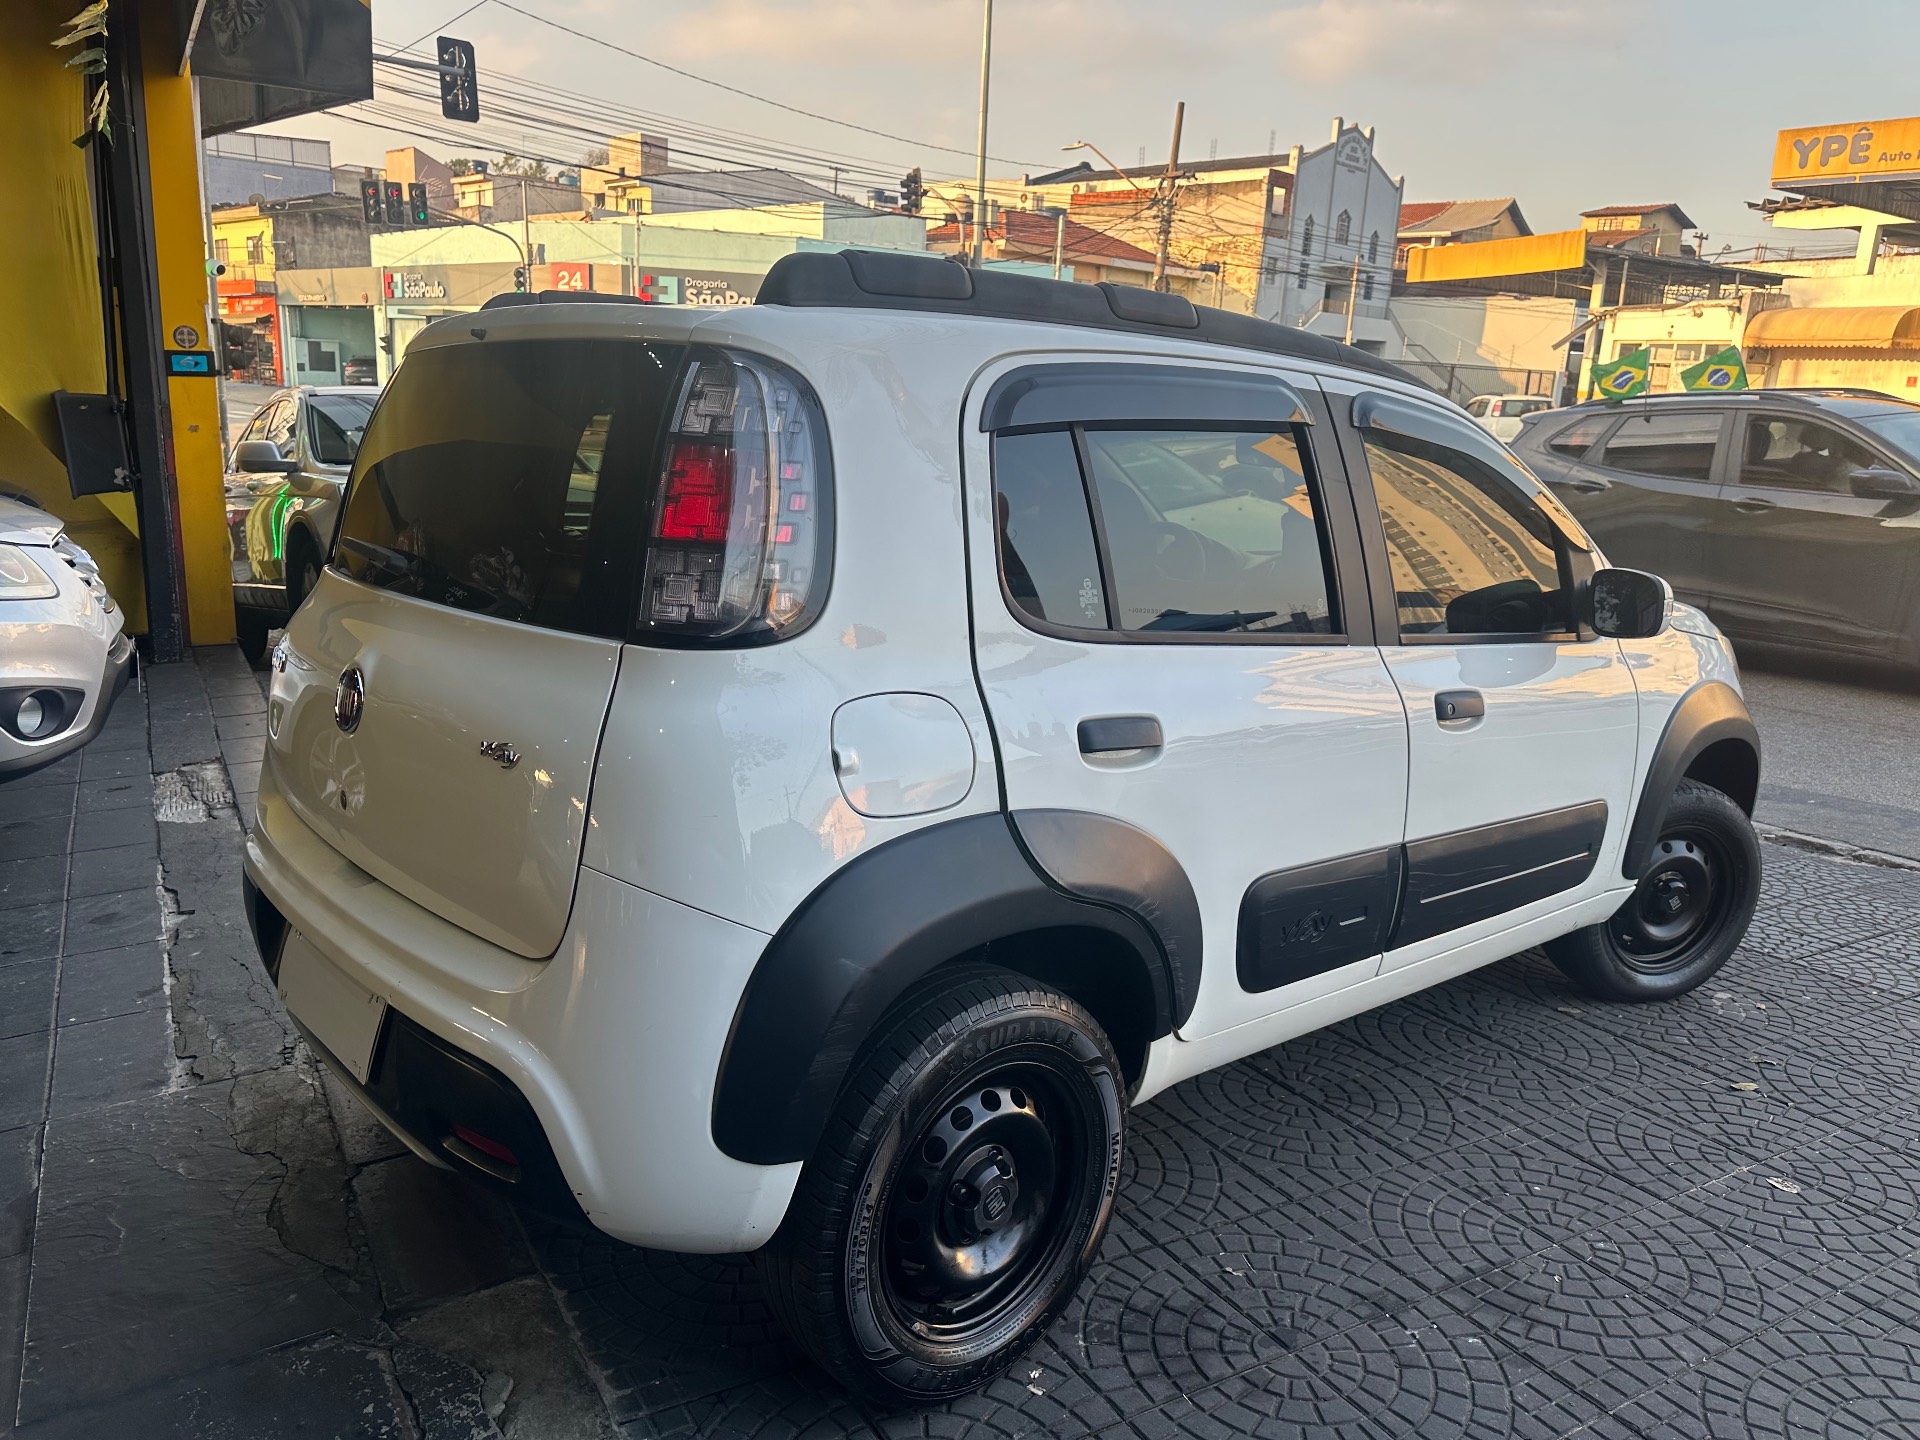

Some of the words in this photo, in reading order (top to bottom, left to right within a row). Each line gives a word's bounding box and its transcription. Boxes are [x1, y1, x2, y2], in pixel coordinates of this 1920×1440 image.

[1793, 126, 1873, 169] YPÊ
[1878, 151, 1911, 162] Auto
[557, 271, 583, 290] 24
[685, 277, 728, 289] Drogaria
[986, 1188, 1006, 1218] FIAT
